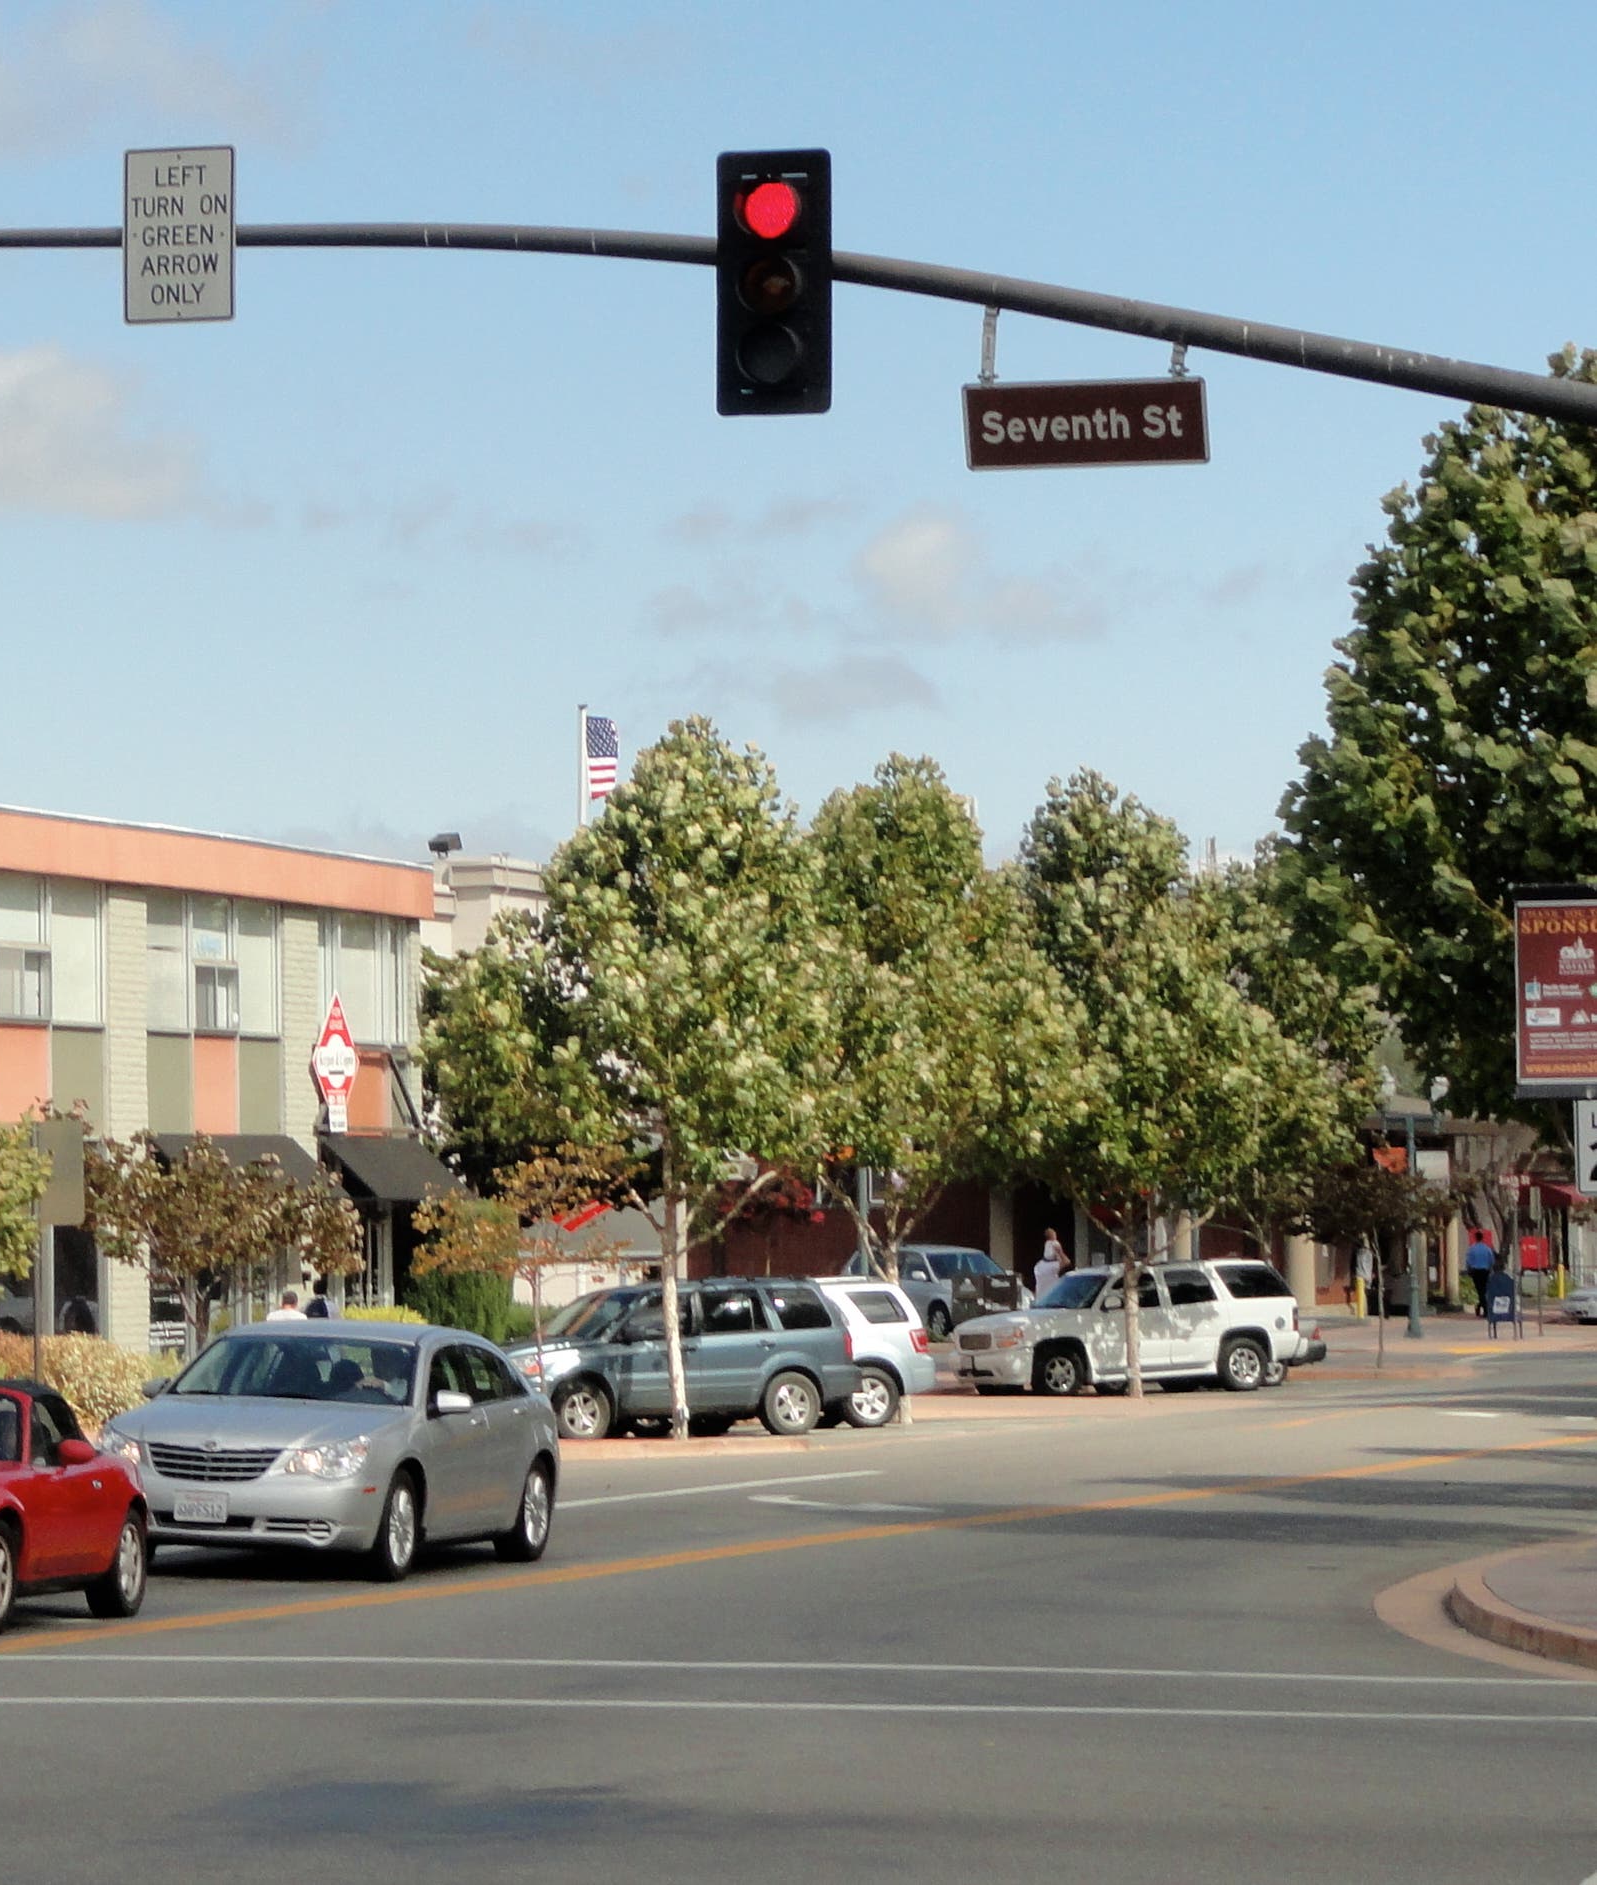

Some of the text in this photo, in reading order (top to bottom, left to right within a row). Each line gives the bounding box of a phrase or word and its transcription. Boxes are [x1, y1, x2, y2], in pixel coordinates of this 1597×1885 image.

[155, 165, 207, 187] LEFT
[131, 194, 227, 218] TURN ON
[142, 224, 214, 247] GREEN
[140, 253, 219, 277] ARROW
[151, 282, 205, 305] ONLY
[981, 404, 1184, 445] Seventh St
